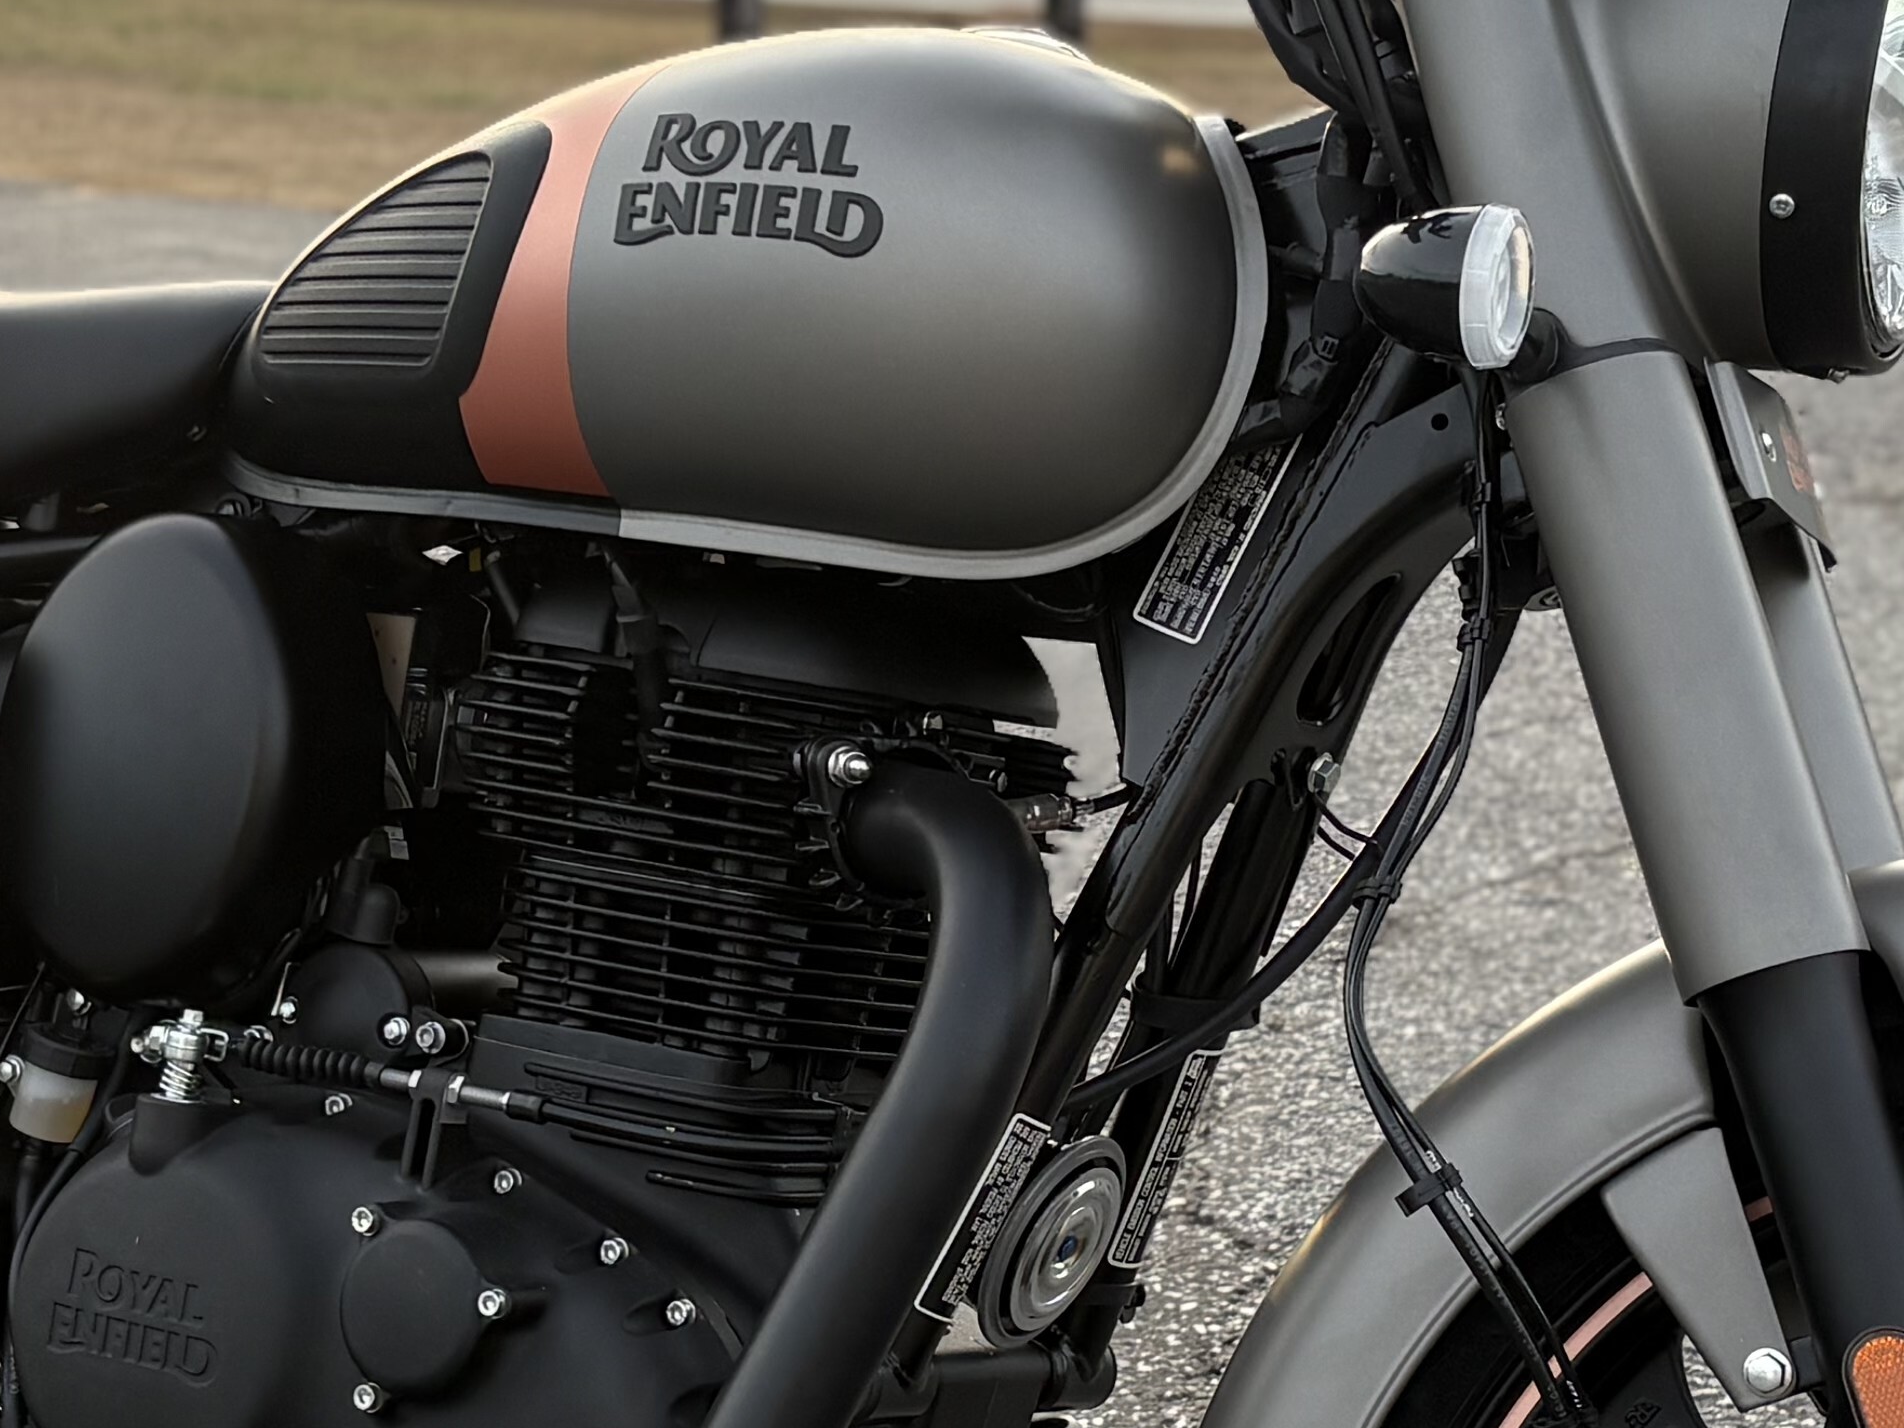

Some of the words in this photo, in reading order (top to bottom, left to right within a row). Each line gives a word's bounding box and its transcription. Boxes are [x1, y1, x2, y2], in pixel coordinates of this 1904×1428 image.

[642, 113, 859, 177] ROYAL
[613, 181, 884, 258] ENFIELD
[68, 1246, 204, 1324] ROYAL
[47, 1303, 222, 1388] ENFIELD
